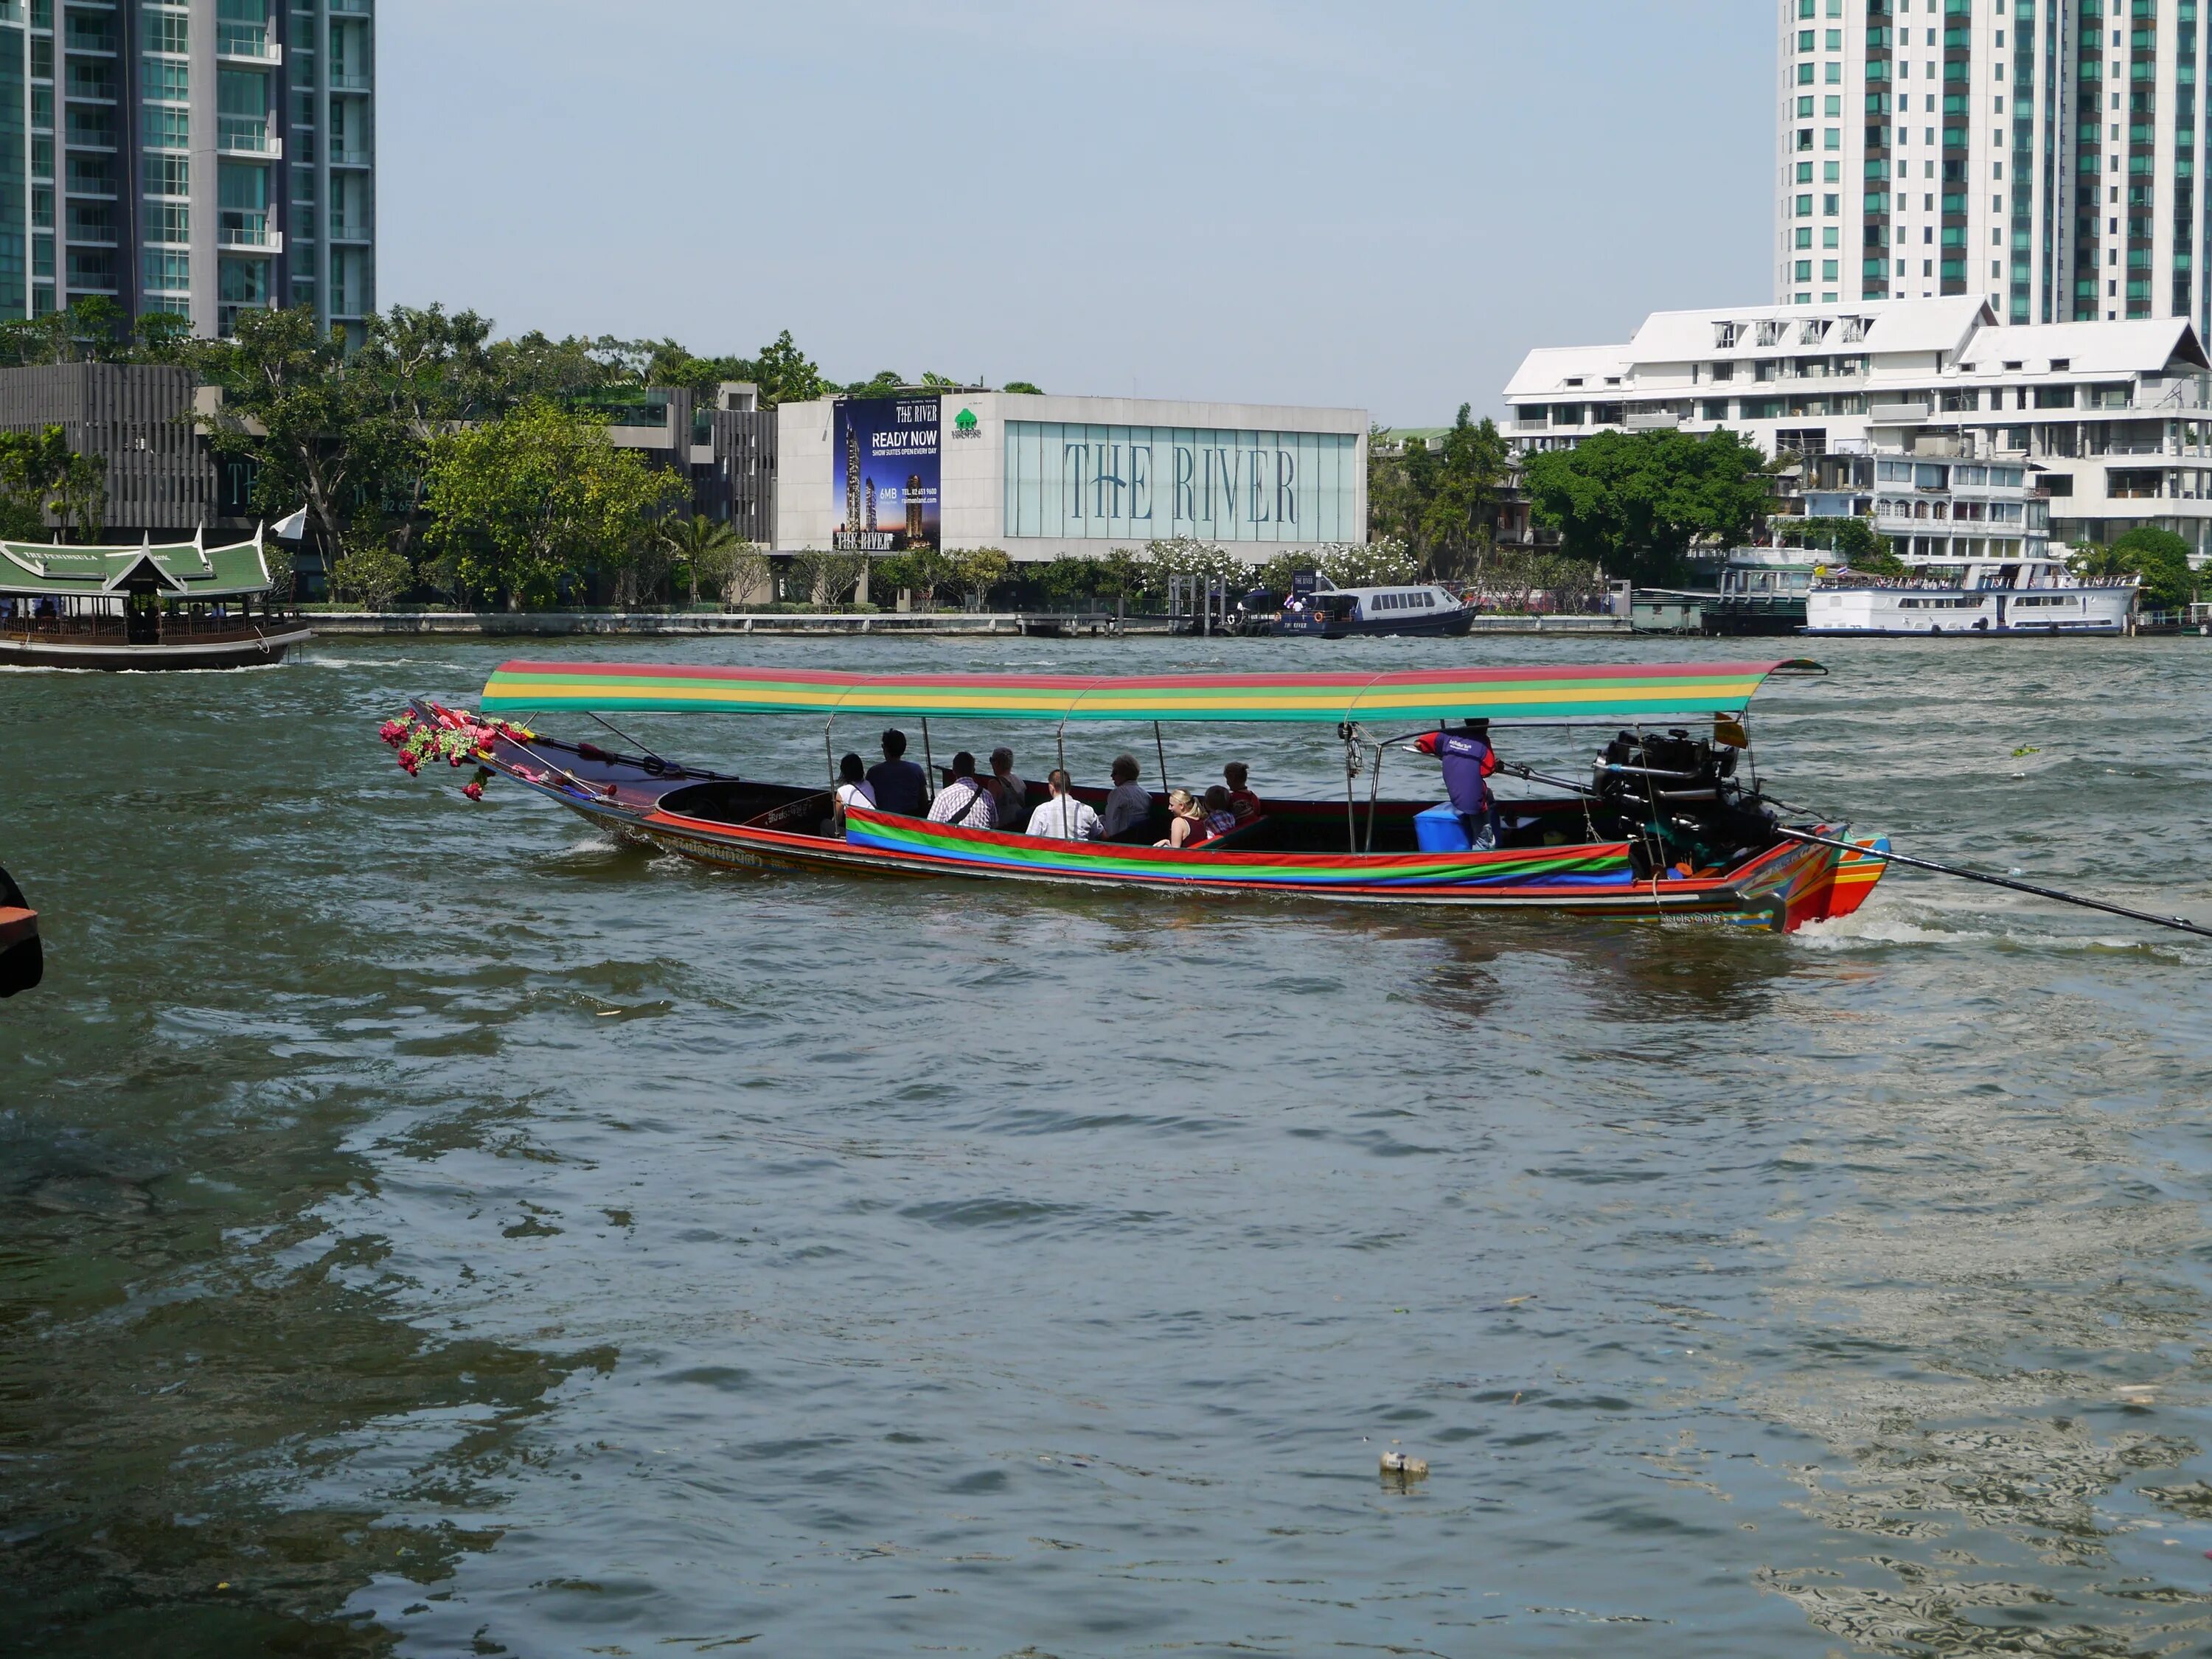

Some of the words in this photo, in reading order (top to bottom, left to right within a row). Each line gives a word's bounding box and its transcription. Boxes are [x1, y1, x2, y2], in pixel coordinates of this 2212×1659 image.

[896, 406, 912, 423] THE
[914, 405, 937, 422] RIVER
[872, 431, 908, 448] READY
[911, 430, 937, 446] NOW
[1065, 444, 1152, 519] THE
[1173, 447, 1298, 524] RIVER
[880, 488, 897, 499] 6MB
[836, 532, 858, 550] THE
